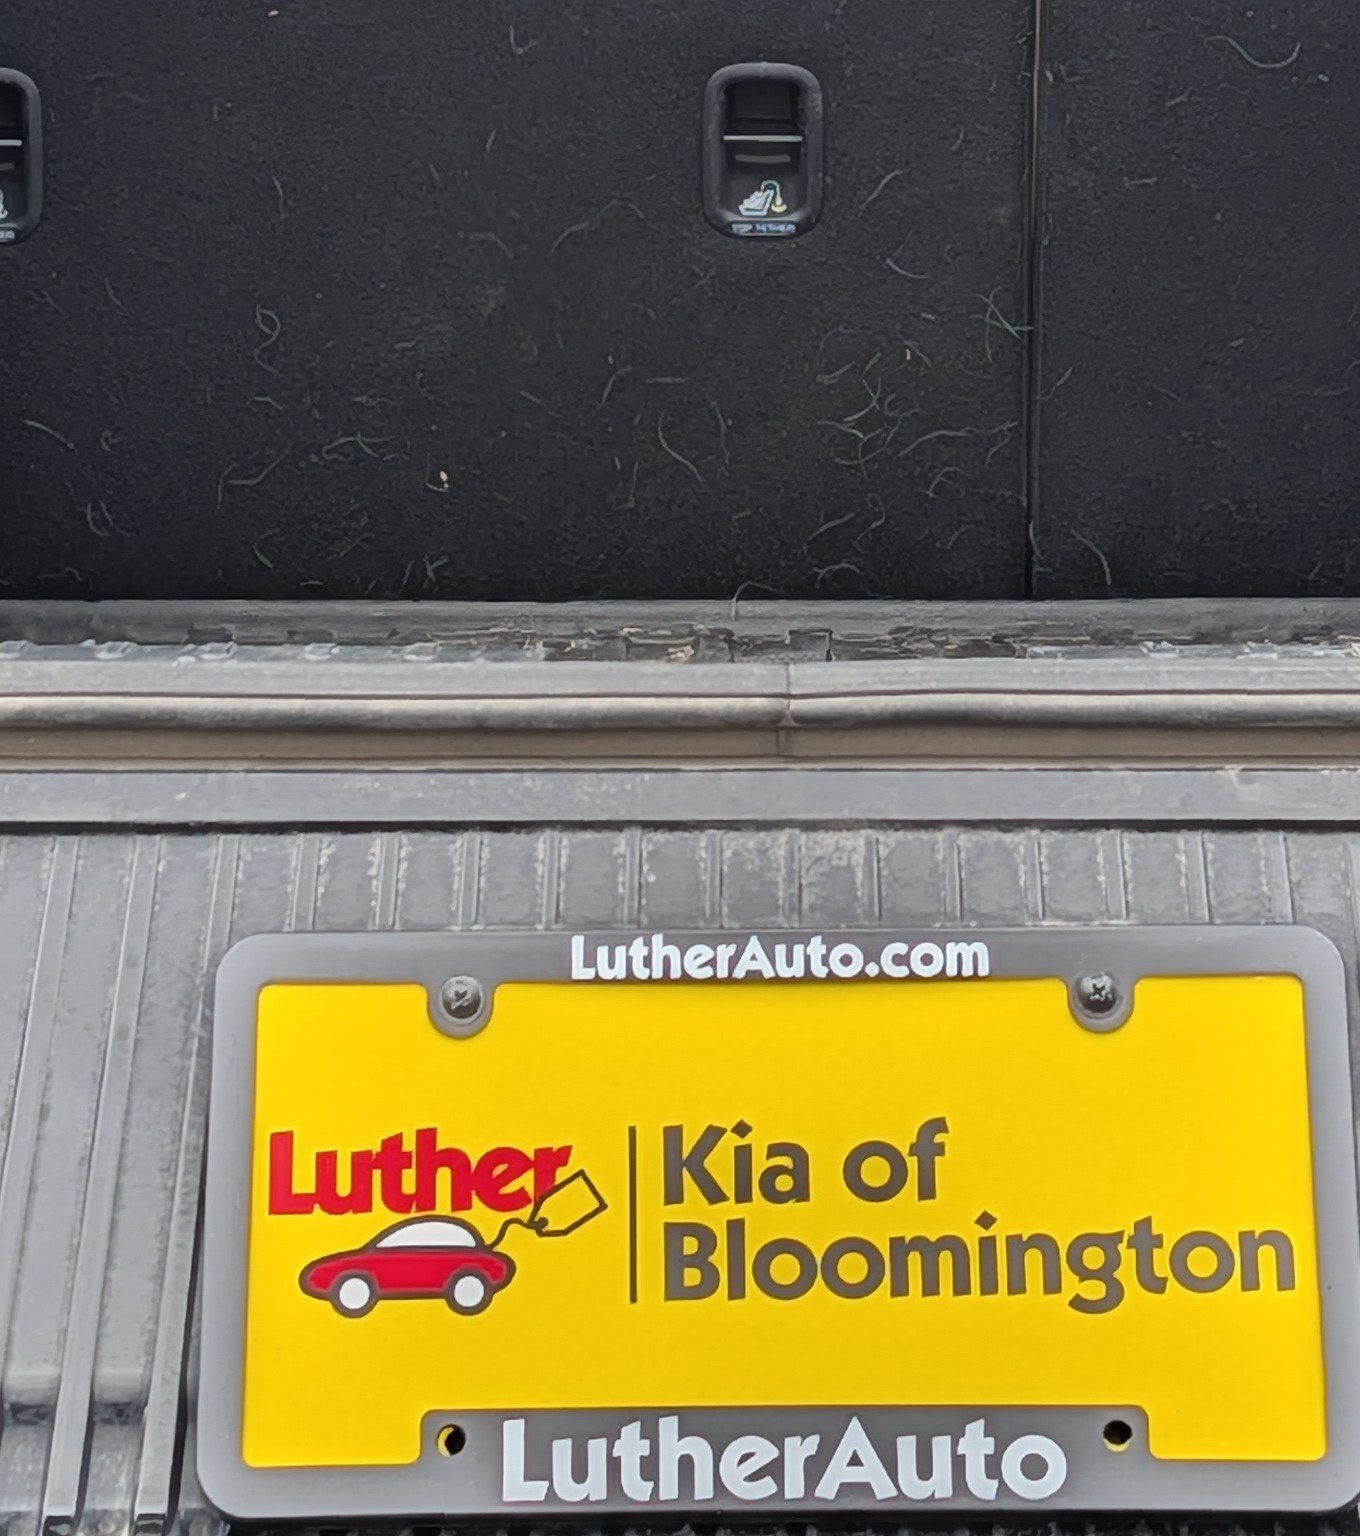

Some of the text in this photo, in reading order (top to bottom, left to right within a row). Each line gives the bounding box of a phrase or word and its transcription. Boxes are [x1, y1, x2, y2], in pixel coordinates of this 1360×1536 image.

[571, 933, 990, 980] LutherAuto.com
[268, 1127, 573, 1216] Luther
[663, 1117, 949, 1206] Kia of
[663, 1210, 1296, 1315] Bloomington
[502, 1415, 1067, 1503] LutherAuto
